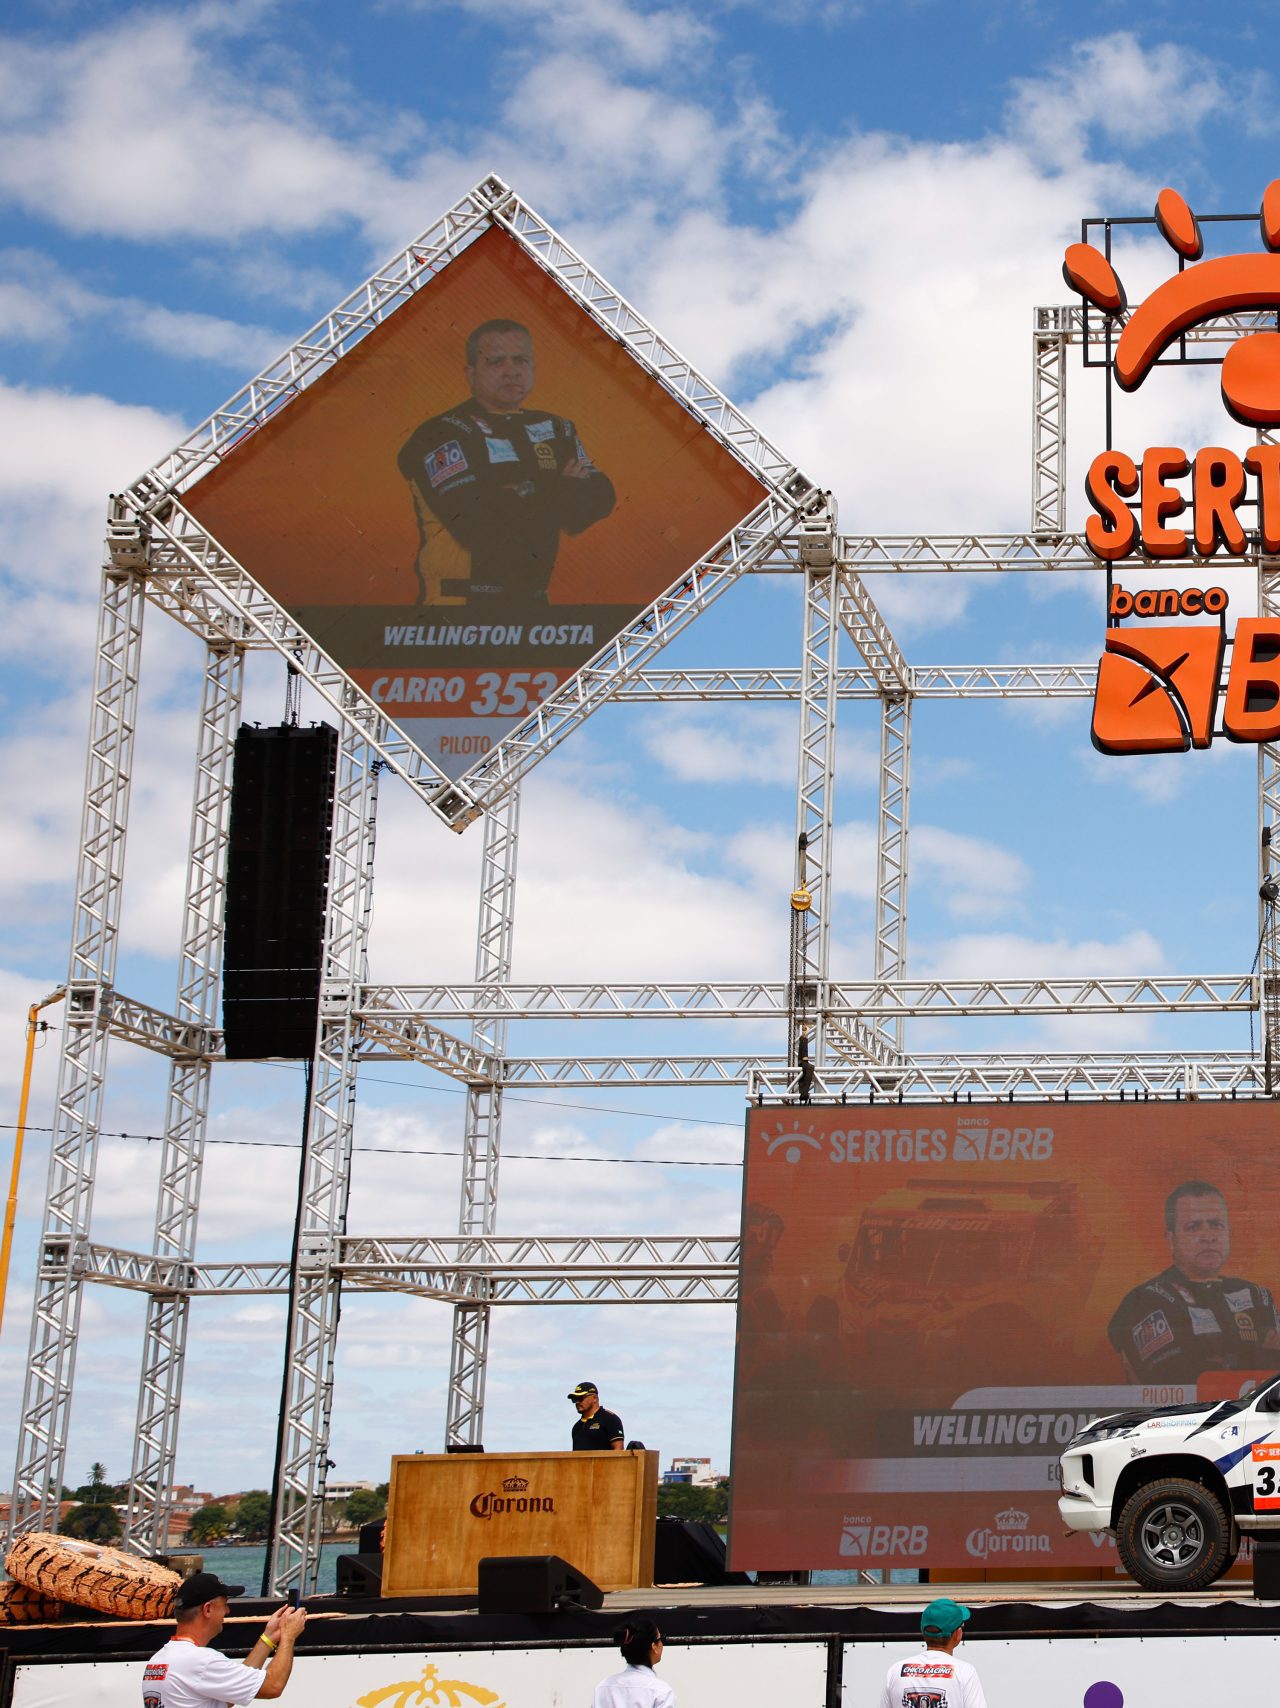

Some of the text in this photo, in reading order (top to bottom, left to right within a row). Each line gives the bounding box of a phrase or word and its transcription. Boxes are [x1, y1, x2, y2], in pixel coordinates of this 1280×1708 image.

[1110, 584, 1229, 618] banco
[384, 624, 594, 646] WELLINGTON COSTA
[370, 672, 558, 716] CARRO 353
[439, 735, 491, 755] PILOTO
[957, 1116, 990, 1126] banco
[988, 1128, 1055, 1162] BRB
[1142, 1387, 1184, 1404] PILOTO
[469, 1491, 555, 1520] Corona
[843, 1515, 872, 1524] banco
[869, 1525, 929, 1556] BRB
[966, 1527, 1051, 1560] Corona
